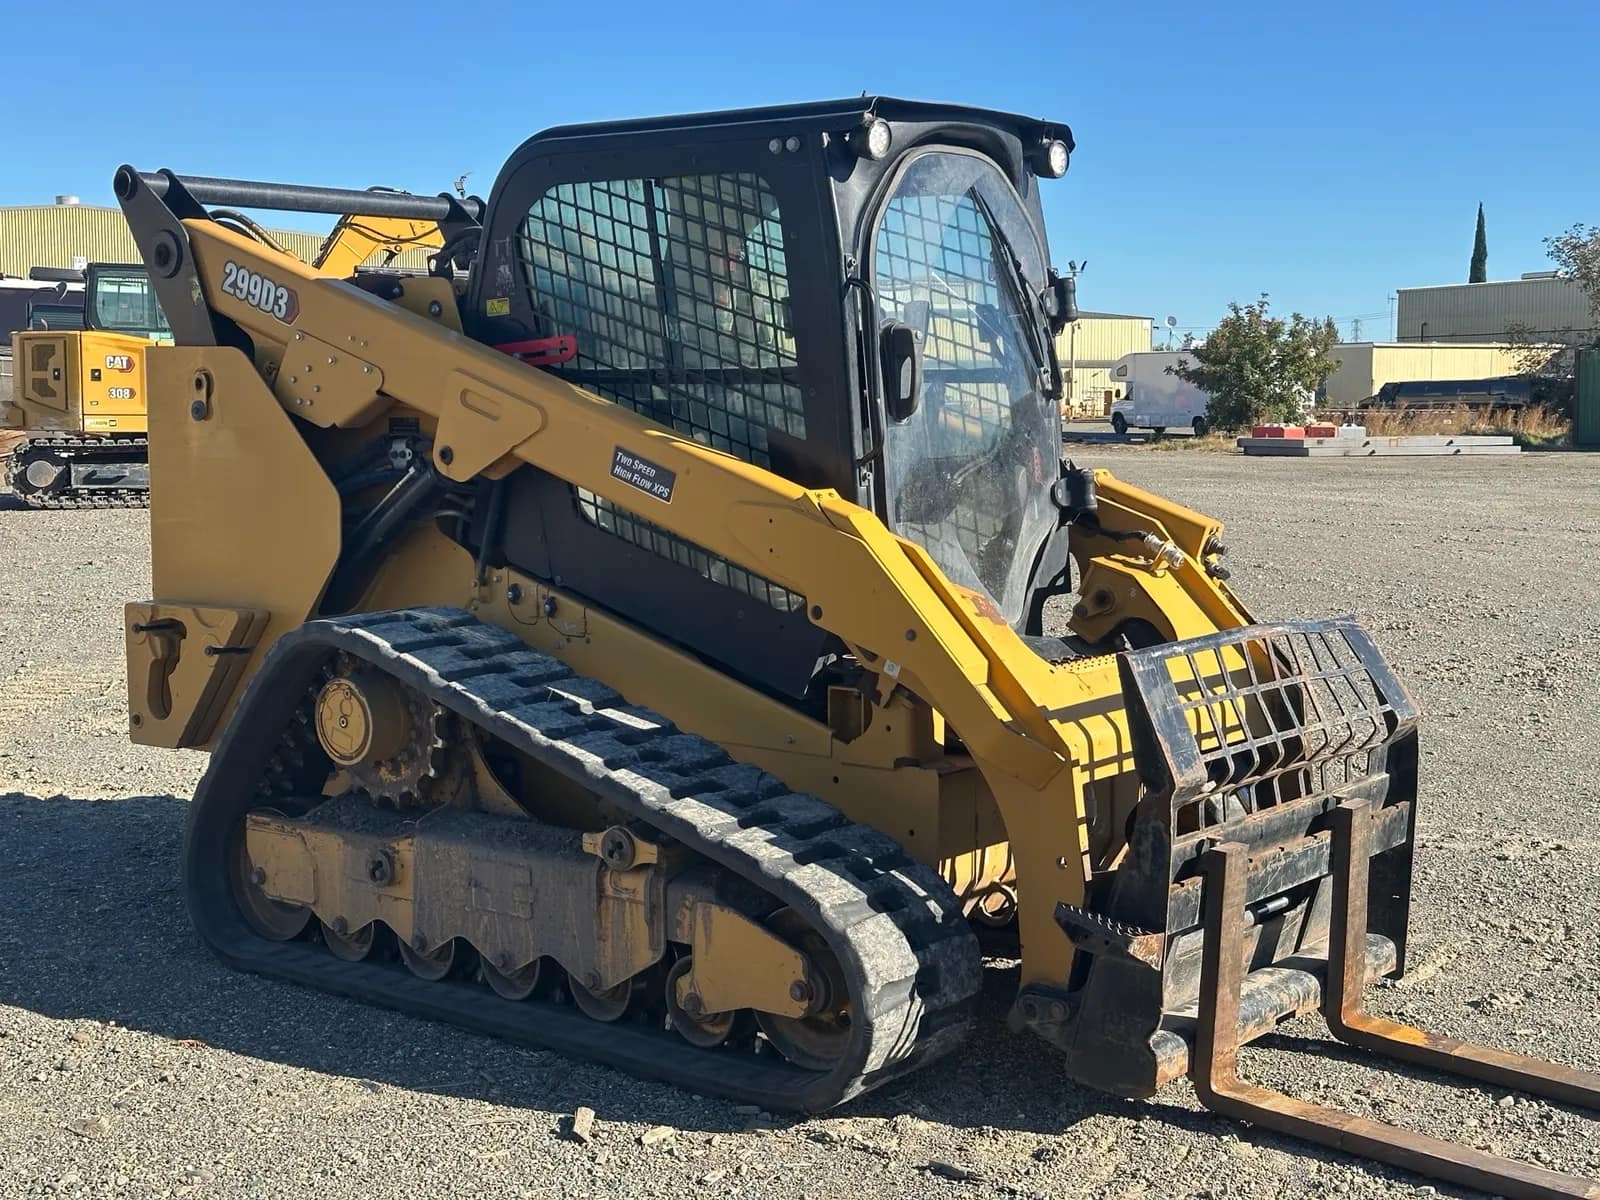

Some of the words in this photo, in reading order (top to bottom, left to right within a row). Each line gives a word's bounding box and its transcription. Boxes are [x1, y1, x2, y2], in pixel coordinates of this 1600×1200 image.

[222, 261, 289, 319] 299D3
[106, 356, 128, 369] CAT
[109, 388, 130, 399] 308
[652, 482, 670, 498] XPS
